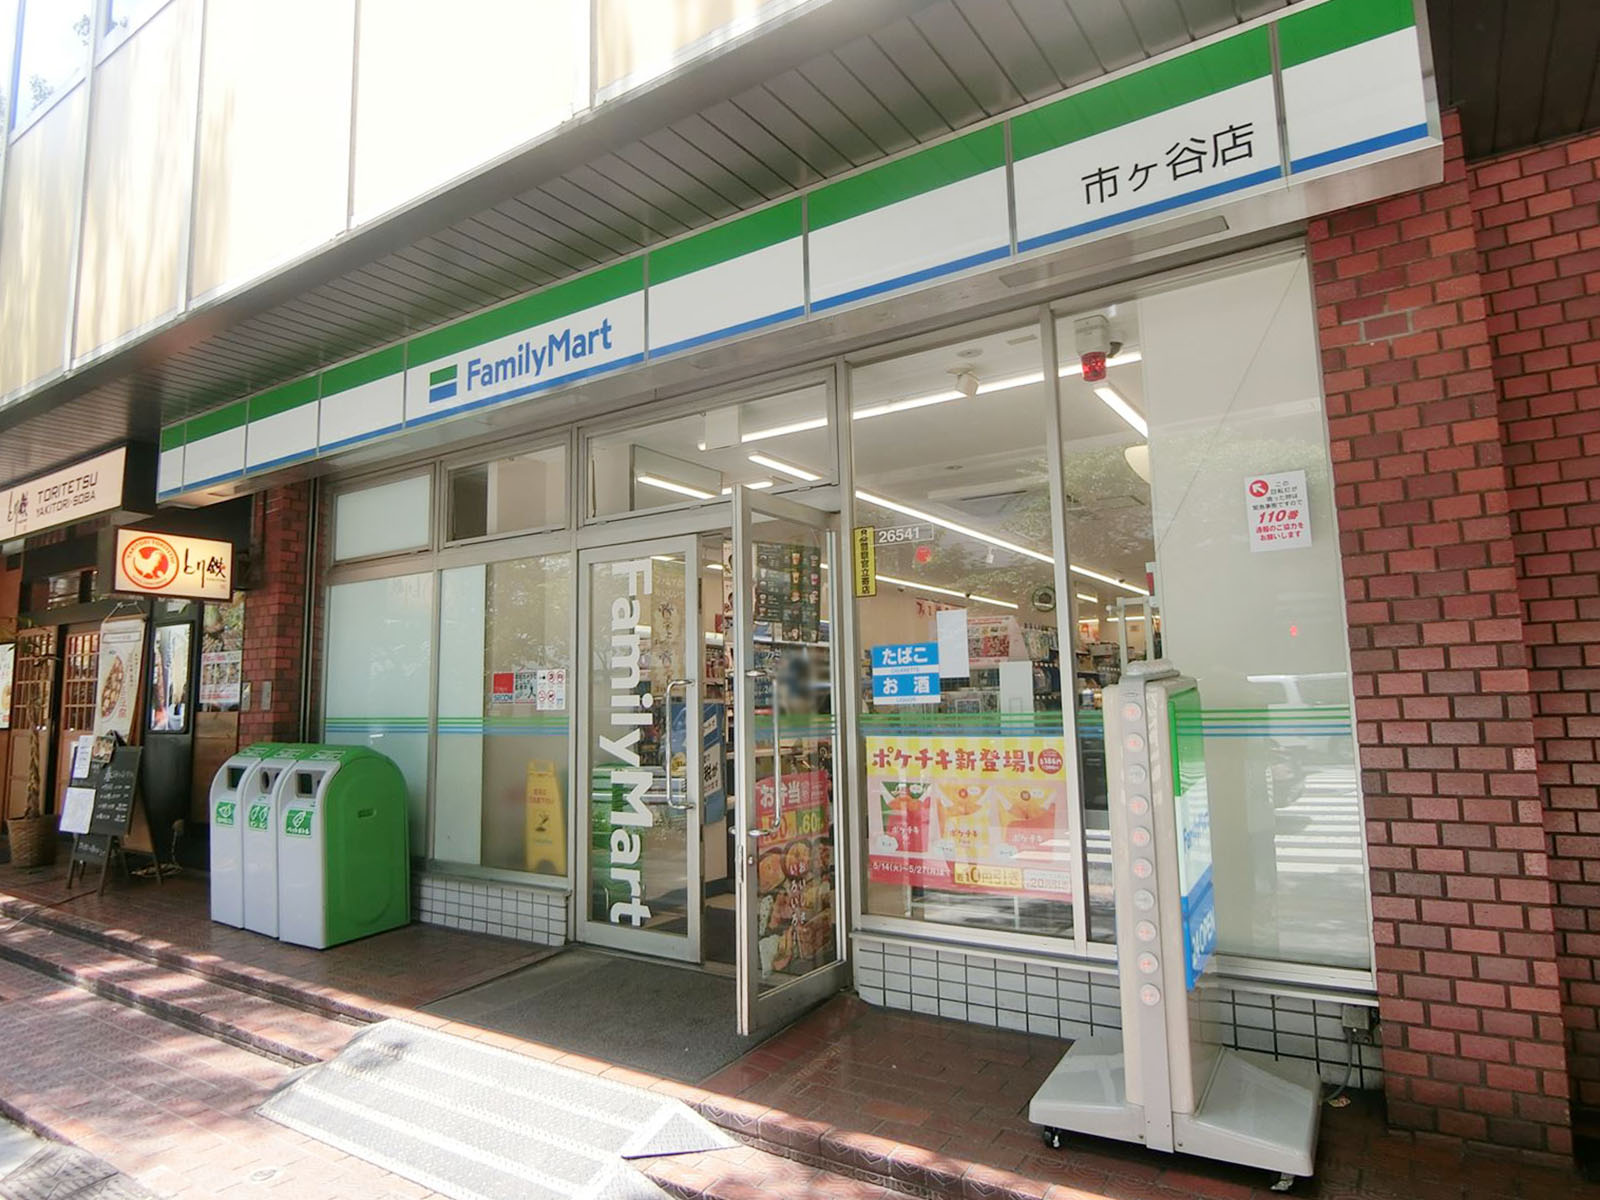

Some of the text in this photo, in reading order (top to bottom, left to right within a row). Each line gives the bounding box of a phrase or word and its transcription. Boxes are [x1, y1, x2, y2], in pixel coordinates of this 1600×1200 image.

[467, 318, 613, 392] FamilyMart
[38, 472, 98, 504] TORITETSU
[1259, 510, 1299, 523] 110番
[878, 526, 920, 543] 26541
[882, 646, 929, 665] たばこ
[599, 558, 654, 928] FamilyMart
[871, 746, 1036, 773] ポケチキ新登場!
